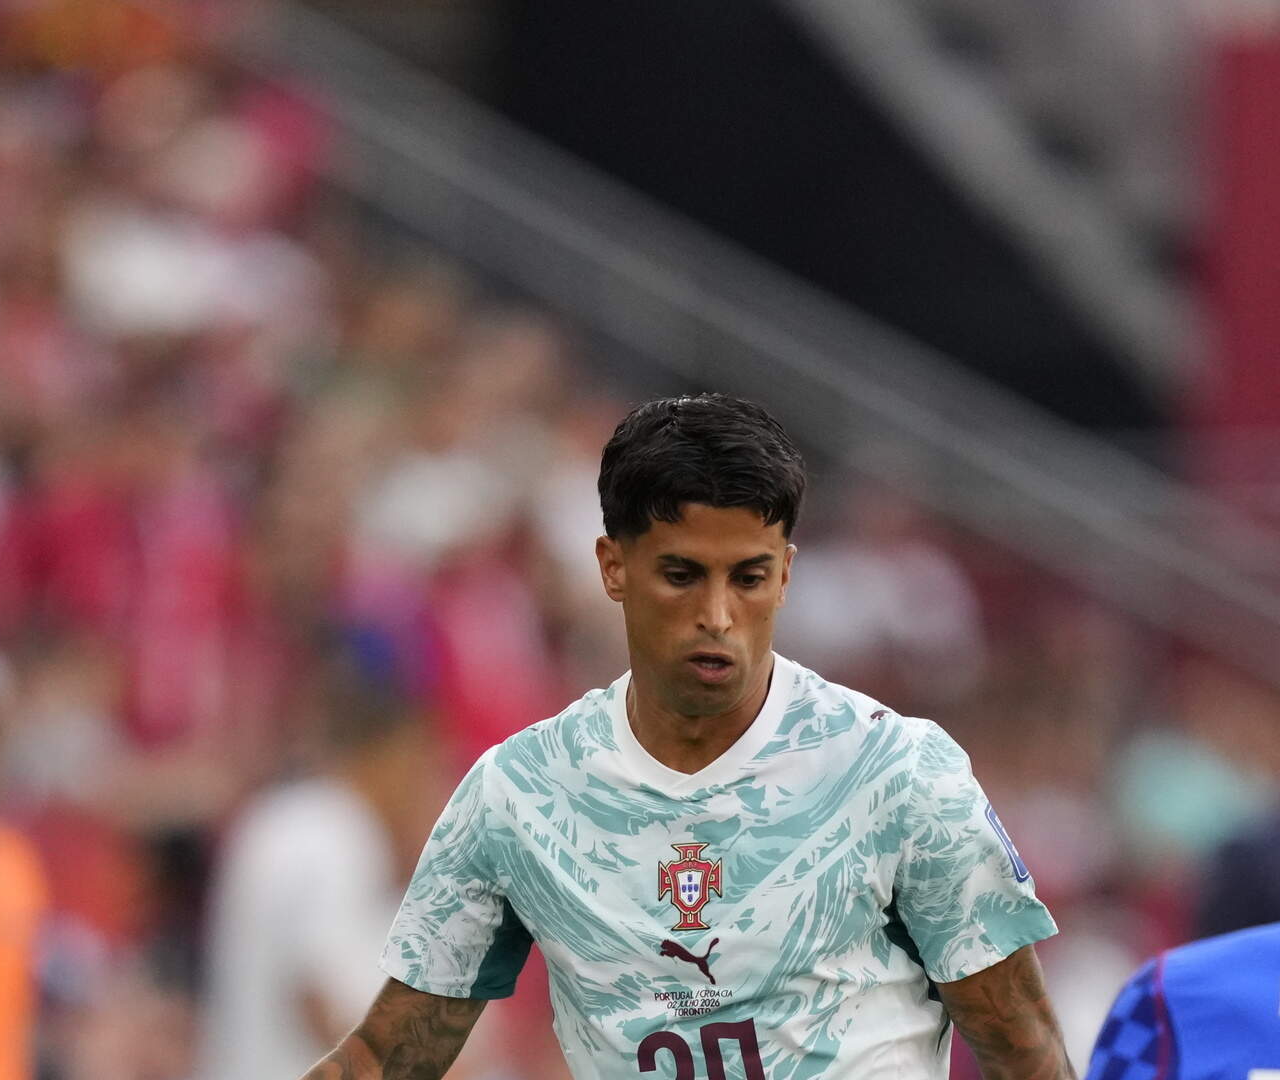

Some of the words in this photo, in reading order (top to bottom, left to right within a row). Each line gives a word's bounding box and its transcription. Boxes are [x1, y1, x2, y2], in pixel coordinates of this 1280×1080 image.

[654, 990, 693, 1001] PORTUGAL
[666, 1000, 678, 1009] 02
[700, 998, 721, 1008] 2026
[674, 1007, 712, 1017] TORONTO
